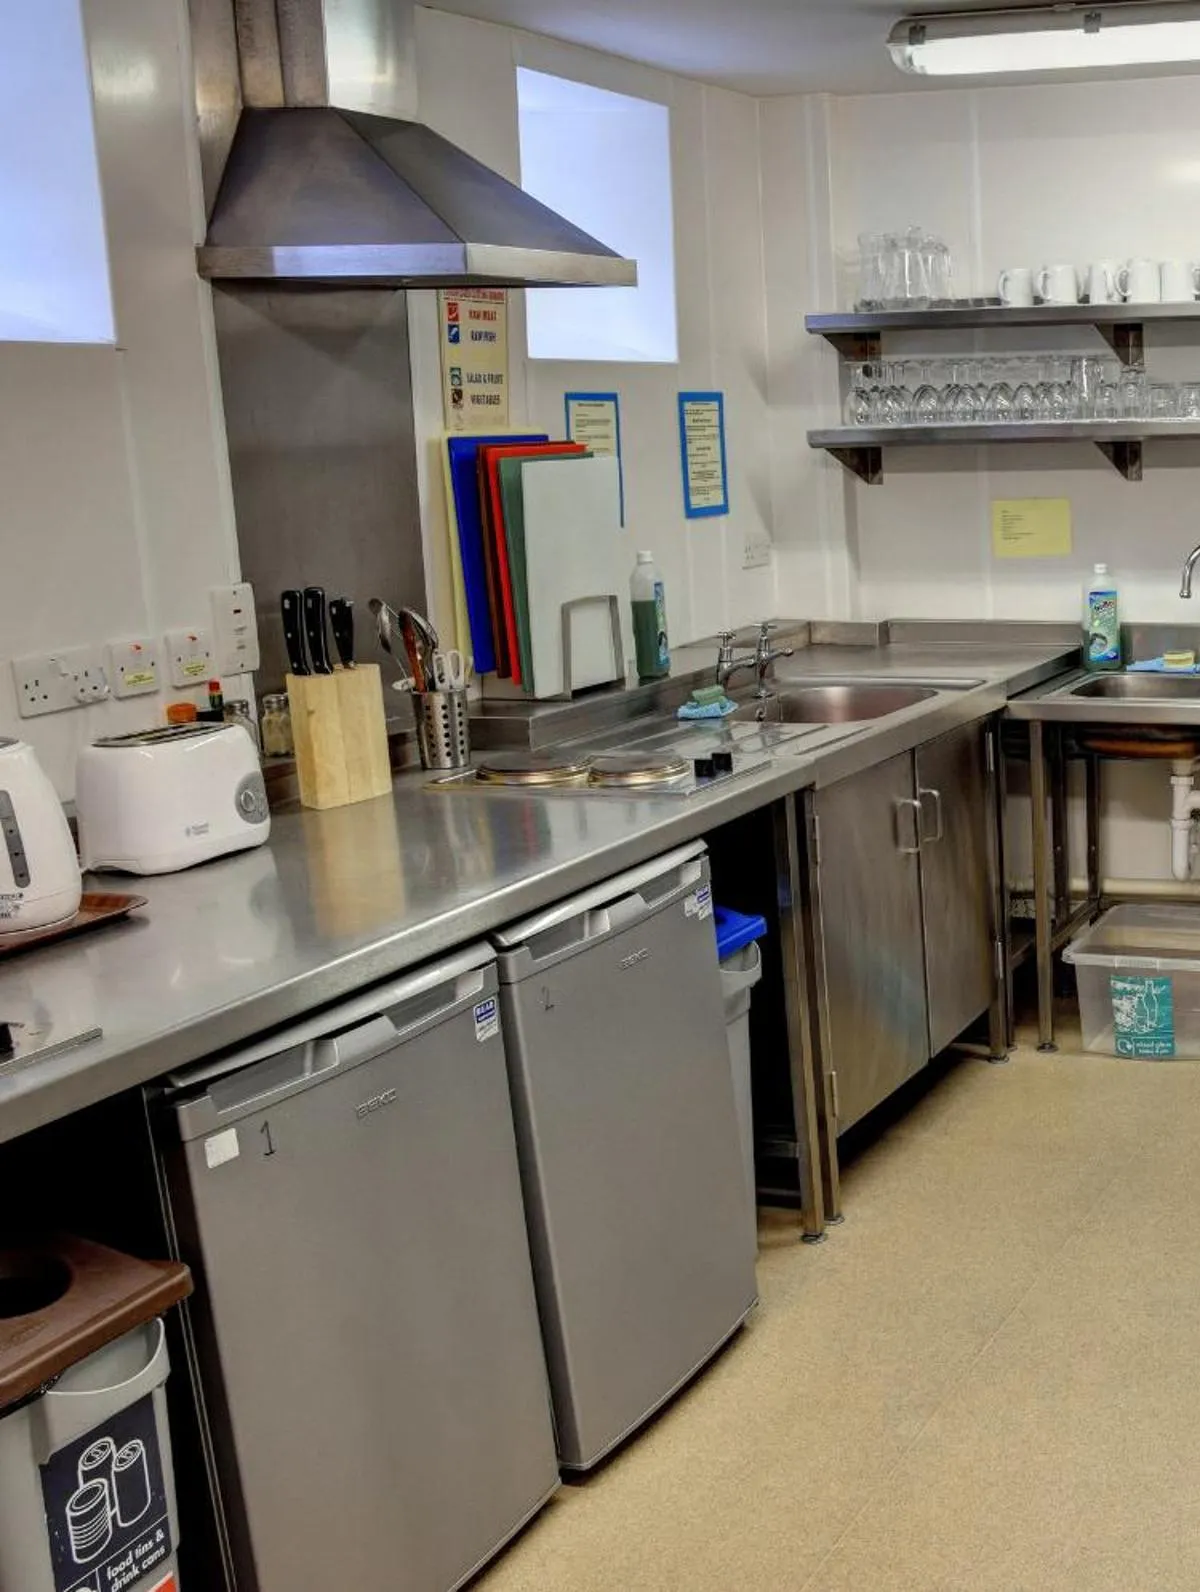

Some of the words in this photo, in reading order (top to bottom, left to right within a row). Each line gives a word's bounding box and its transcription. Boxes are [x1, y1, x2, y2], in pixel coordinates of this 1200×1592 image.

[260, 1120, 277, 1157] 1
[106, 1550, 133, 1581] food
[135, 1540, 154, 1560] tins
[156, 1529, 165, 1543] &
[111, 1563, 140, 1592] drink
[142, 1545, 166, 1570] cans
